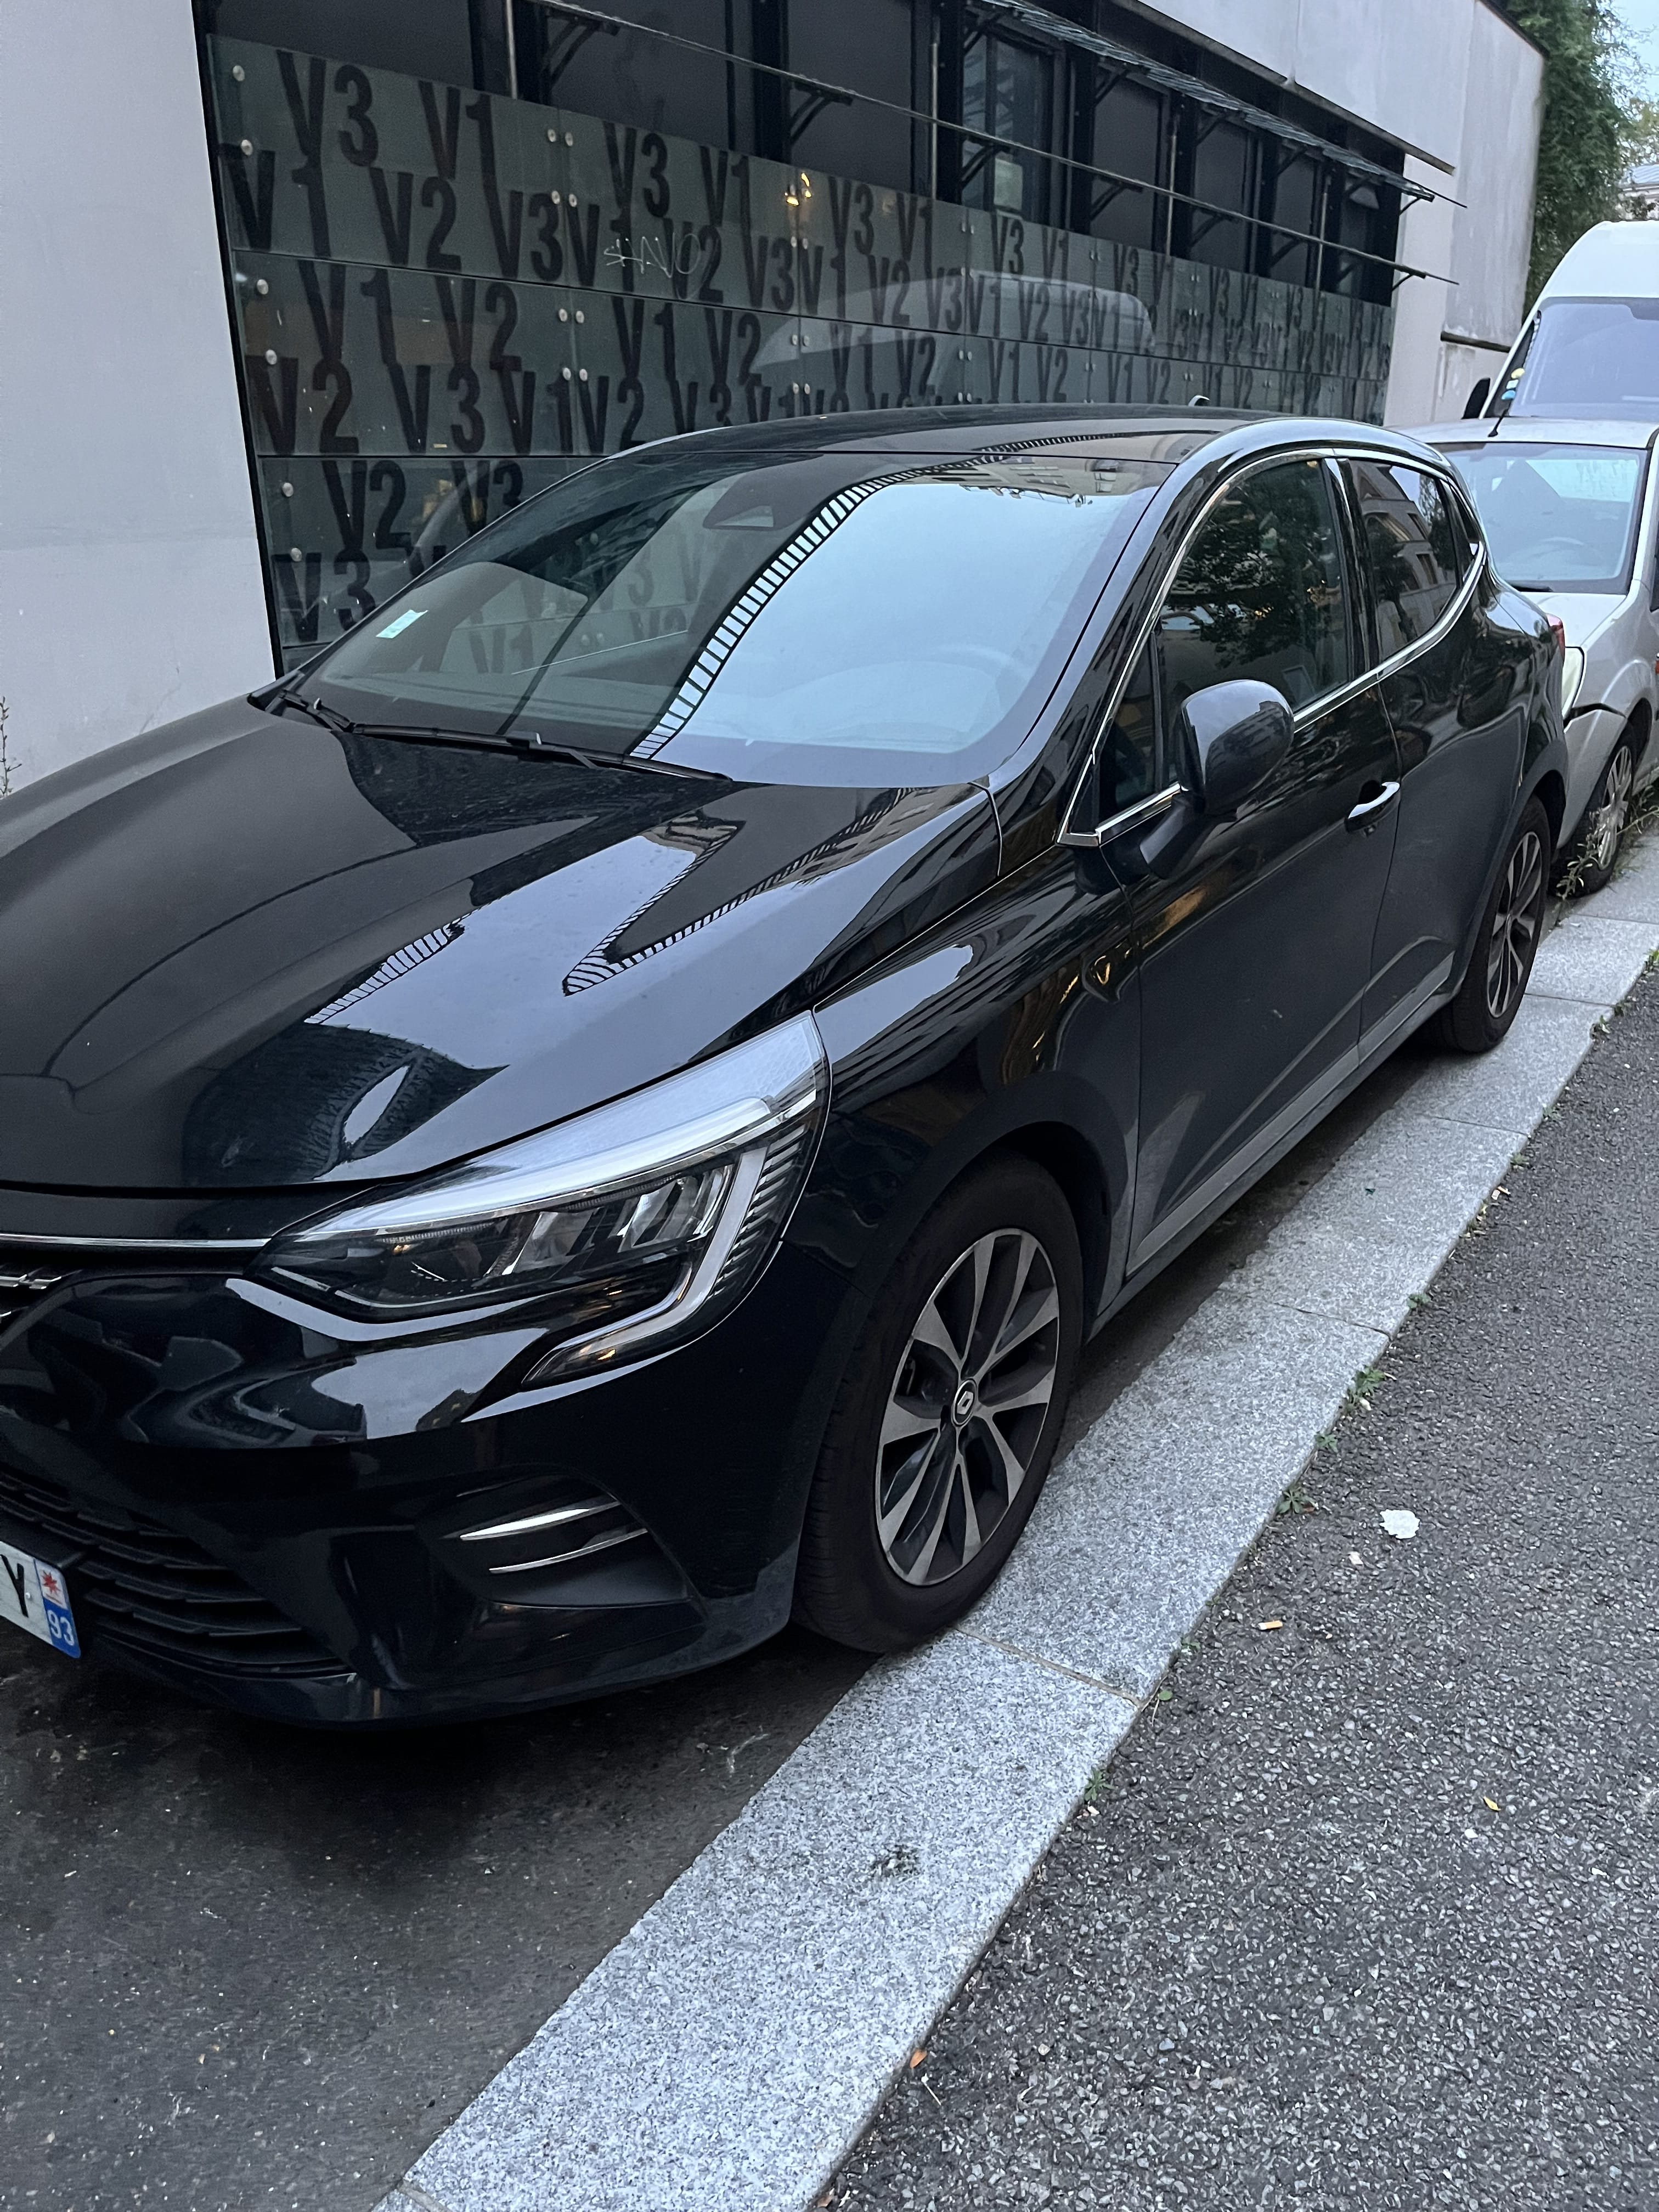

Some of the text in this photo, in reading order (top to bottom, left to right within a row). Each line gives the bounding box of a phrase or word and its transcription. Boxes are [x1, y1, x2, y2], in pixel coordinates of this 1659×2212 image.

[276, 49, 379, 166] V3
[418, 81, 494, 188] V1
[603, 120, 670, 218] V3
[700, 145, 752, 232] V1
[828, 176, 874, 255] V3
[896, 192, 934, 264] V1
[991, 211, 1024, 274] V3
[1042, 226, 1069, 280] V1
[218, 143, 331, 257] V1
[369, 167, 462, 273] V2
[484, 190, 563, 281] V3
[567, 204, 634, 292] V1
[662, 218, 724, 303] V2
[743, 235, 794, 312] V3
[799, 245, 846, 319] V1
[867, 254, 910, 326] V2
[925, 267, 963, 331] V3
[967, 274, 1001, 337] V1
[1018, 278, 1049, 342] V2
[298, 259, 398, 363] V1
[433, 276, 522, 370] V2
[610, 296, 676, 380] V1
[704, 308, 761, 385] V2
[830, 323, 874, 391] V1
[895, 330, 936, 396] V2
[989, 339, 1020, 401] V1
[1037, 346, 1068, 402] V2
[245, 356, 359, 454] V2
[385, 364, 486, 454] V3
[496, 370, 574, 455] V1
[578, 376, 647, 454] V2
[322, 460, 412, 549] V2
[271, 549, 377, 641] V3
[0, 1554, 29, 1618] Y
[47, 1610, 75, 1645] 93
